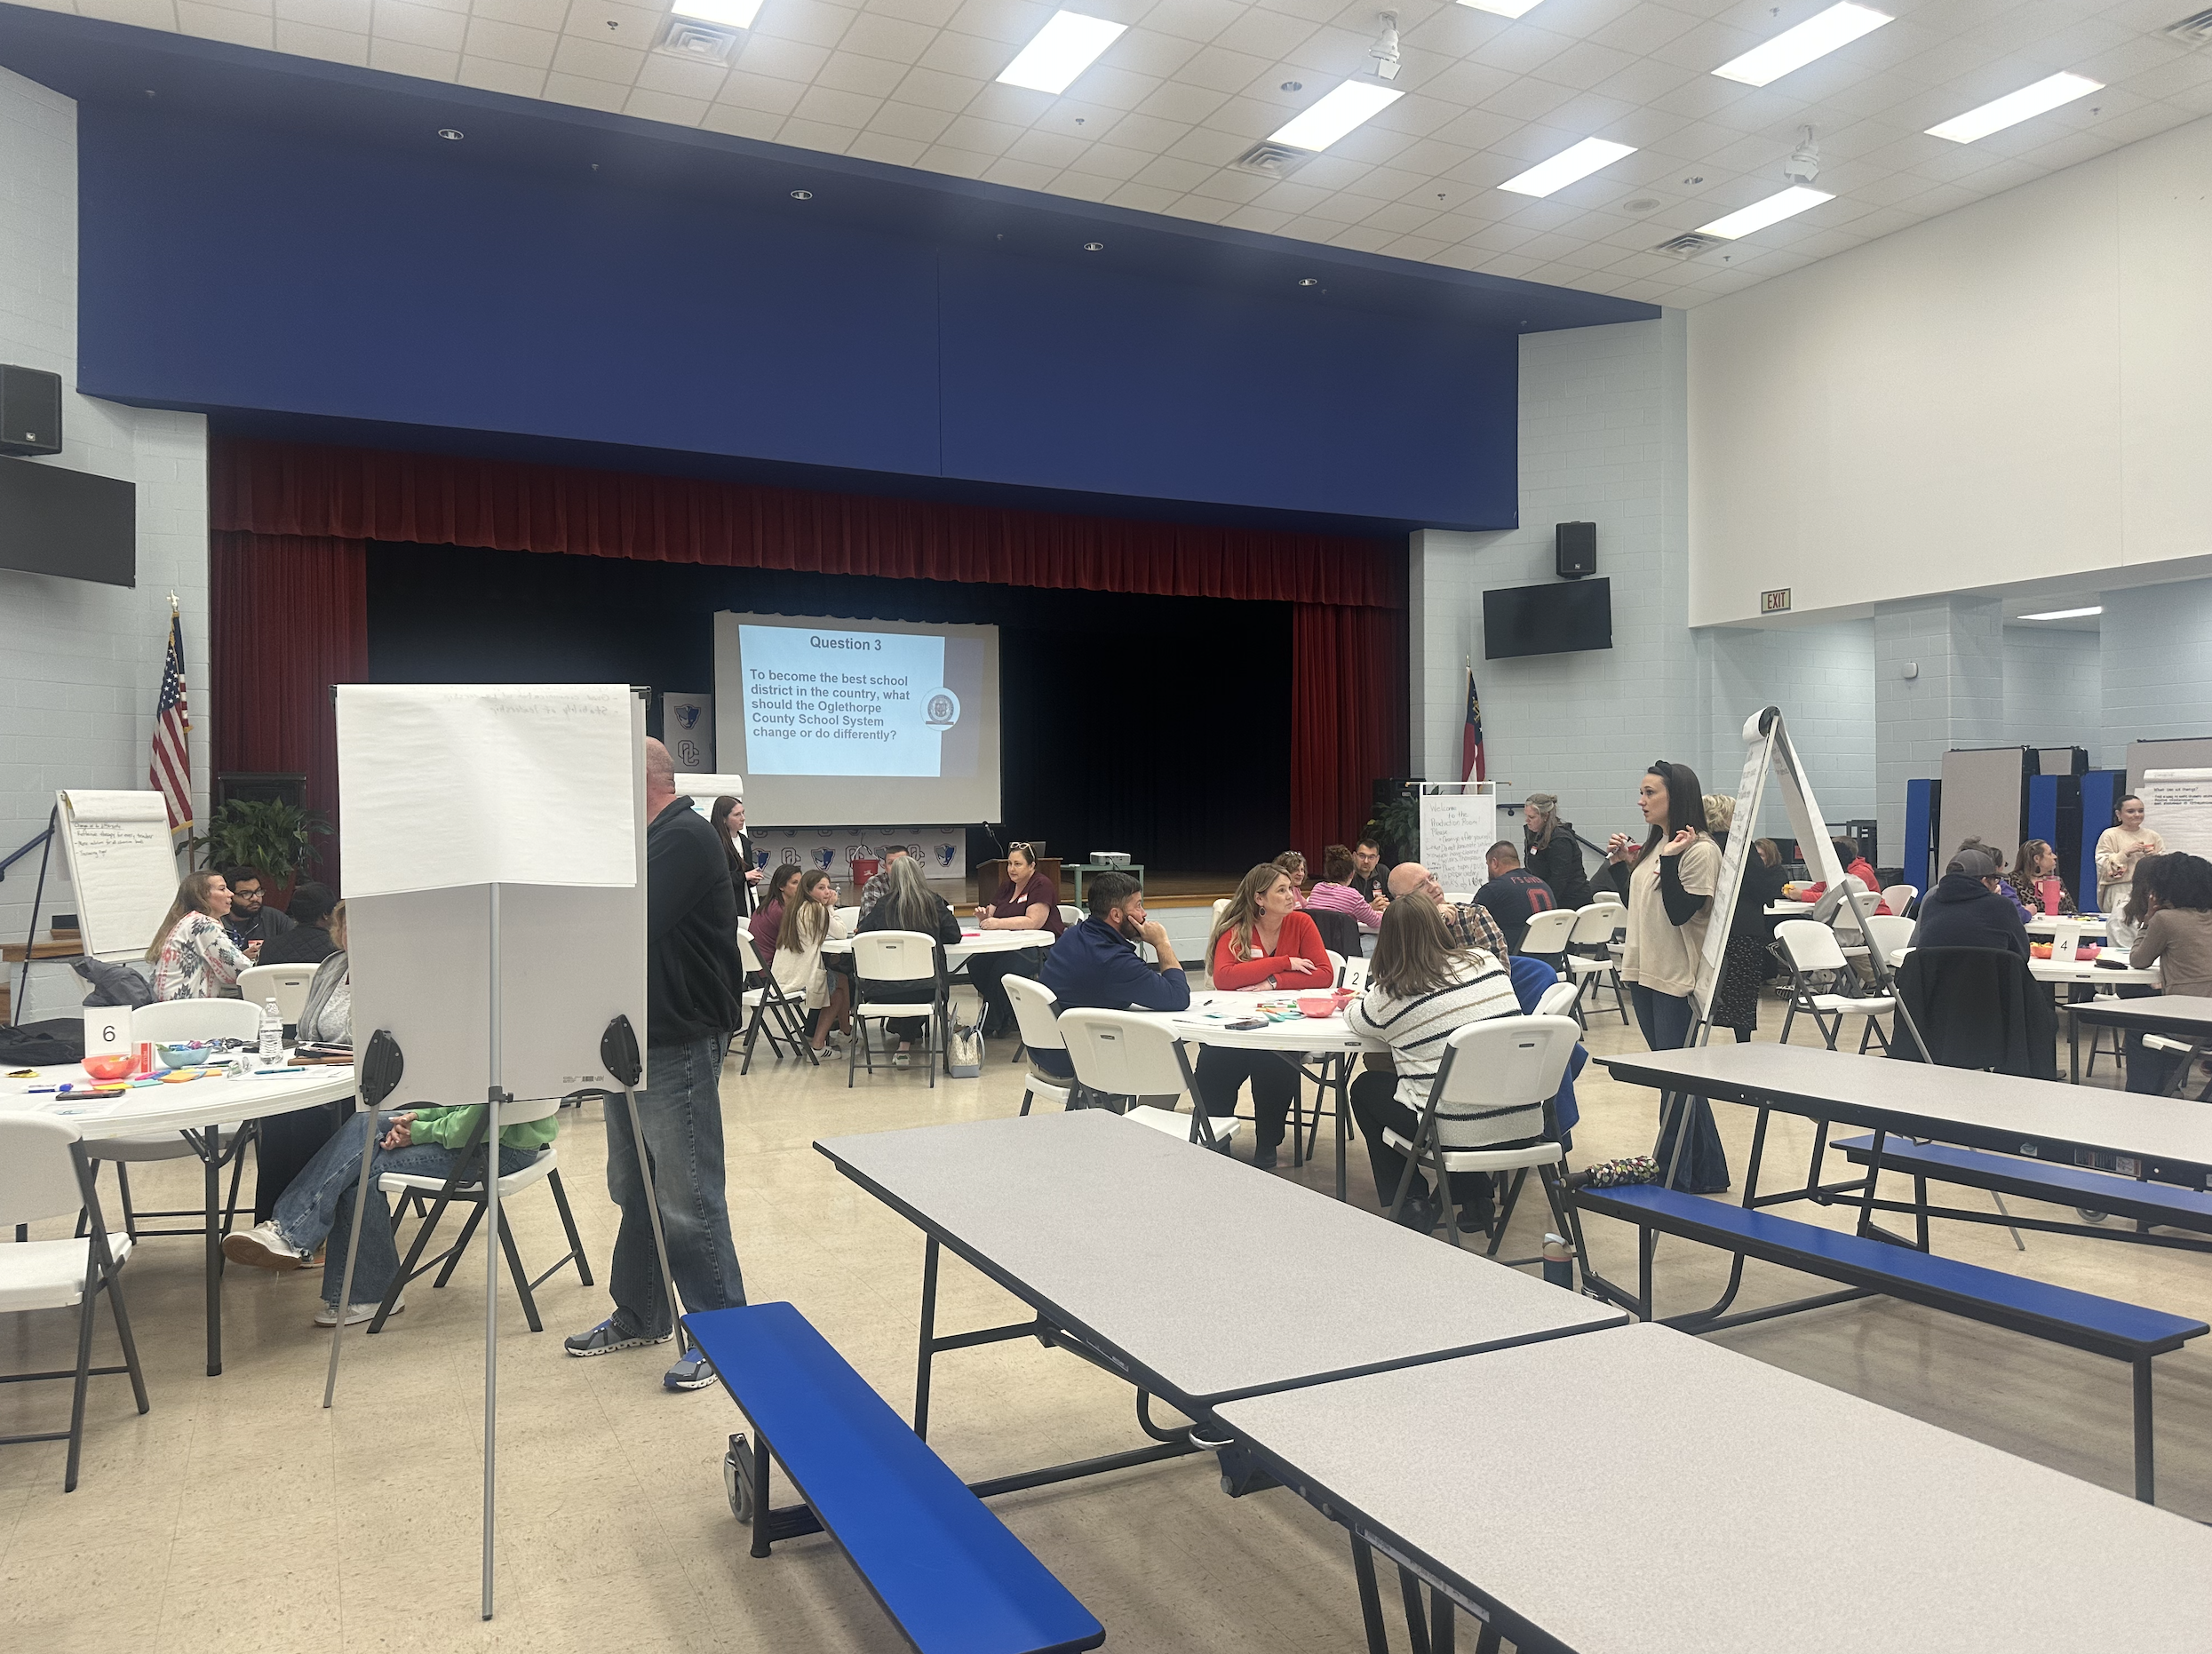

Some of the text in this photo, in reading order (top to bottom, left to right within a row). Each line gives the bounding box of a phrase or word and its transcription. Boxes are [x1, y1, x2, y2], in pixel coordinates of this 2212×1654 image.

[1768, 592, 1786, 609] EXIT
[810, 635, 882, 651] Question 3
[750, 668, 908, 687] To become the best school
[751, 683, 911, 702] district in the country, what
[752, 697, 882, 716] should the Oglethorpe
[752, 712, 884, 728] County School System
[752, 726, 897, 743] change or do differently?
[1429, 802, 1457, 812] Welcome
[1430, 817, 1460, 827] Production
[2060, 940, 2068, 951] 4
[1351, 972, 1360, 985] 2
[102, 1025, 116, 1042] 6
